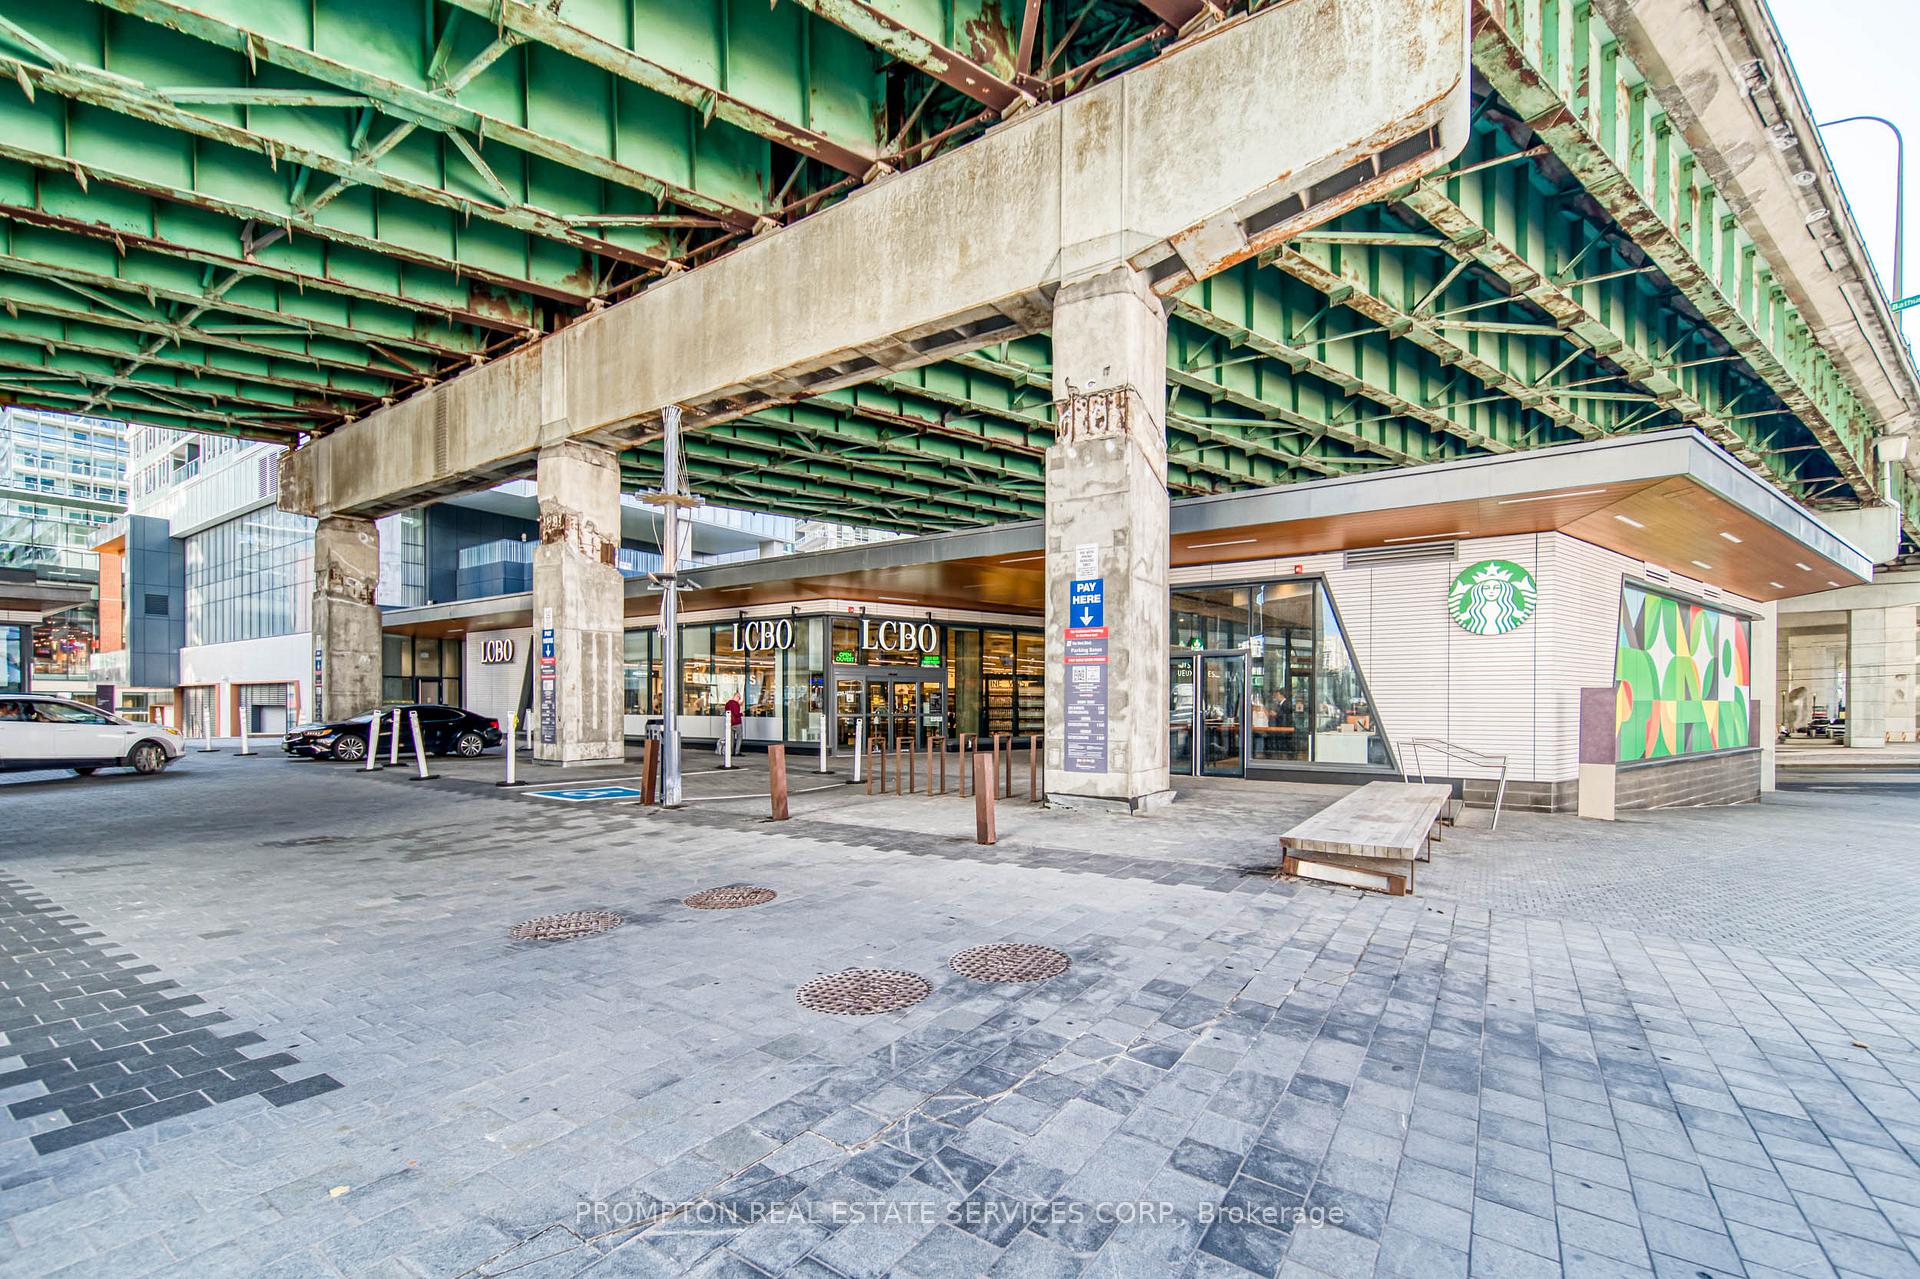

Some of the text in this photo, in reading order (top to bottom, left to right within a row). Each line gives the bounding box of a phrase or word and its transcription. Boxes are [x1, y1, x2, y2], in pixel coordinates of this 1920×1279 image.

[1076, 582, 1097, 592] PAY
[1072, 594, 1101, 604] HERE
[733, 619, 793, 651] LCBO
[862, 619, 937, 652] LCBO
[481, 639, 513, 662] LCBO
